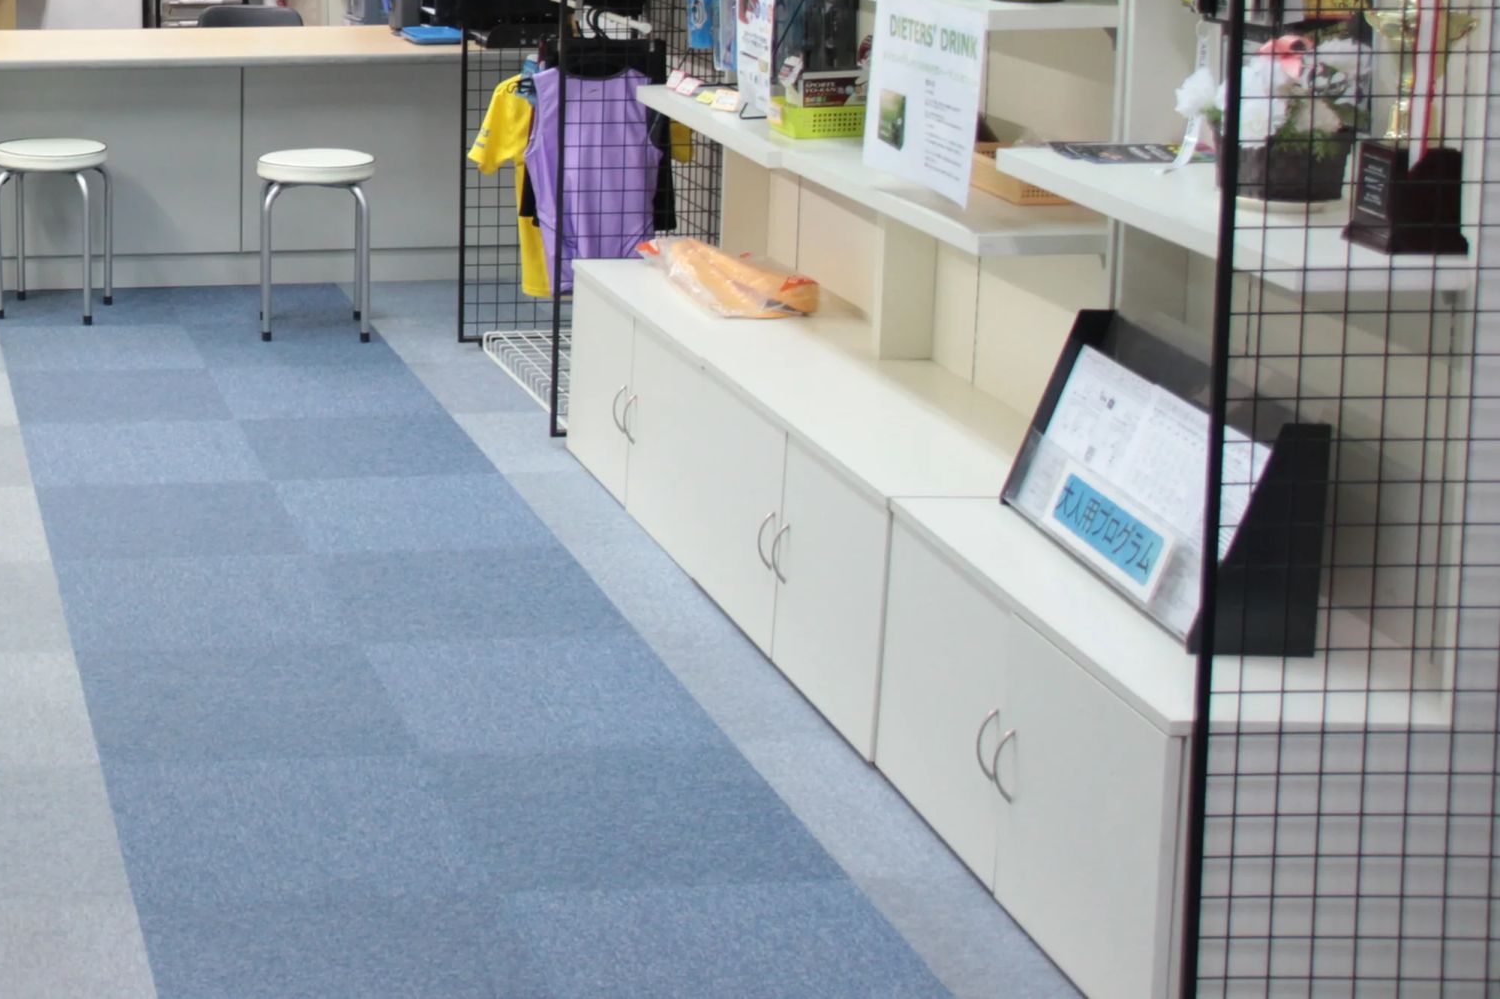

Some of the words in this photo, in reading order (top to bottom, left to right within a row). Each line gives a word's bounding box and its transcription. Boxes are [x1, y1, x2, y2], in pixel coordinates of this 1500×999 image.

[889, 14, 938, 47] DIETERS'
[940, 27, 978, 60] DRINK
[1054, 484, 1154, 575] 大人用プログラム
